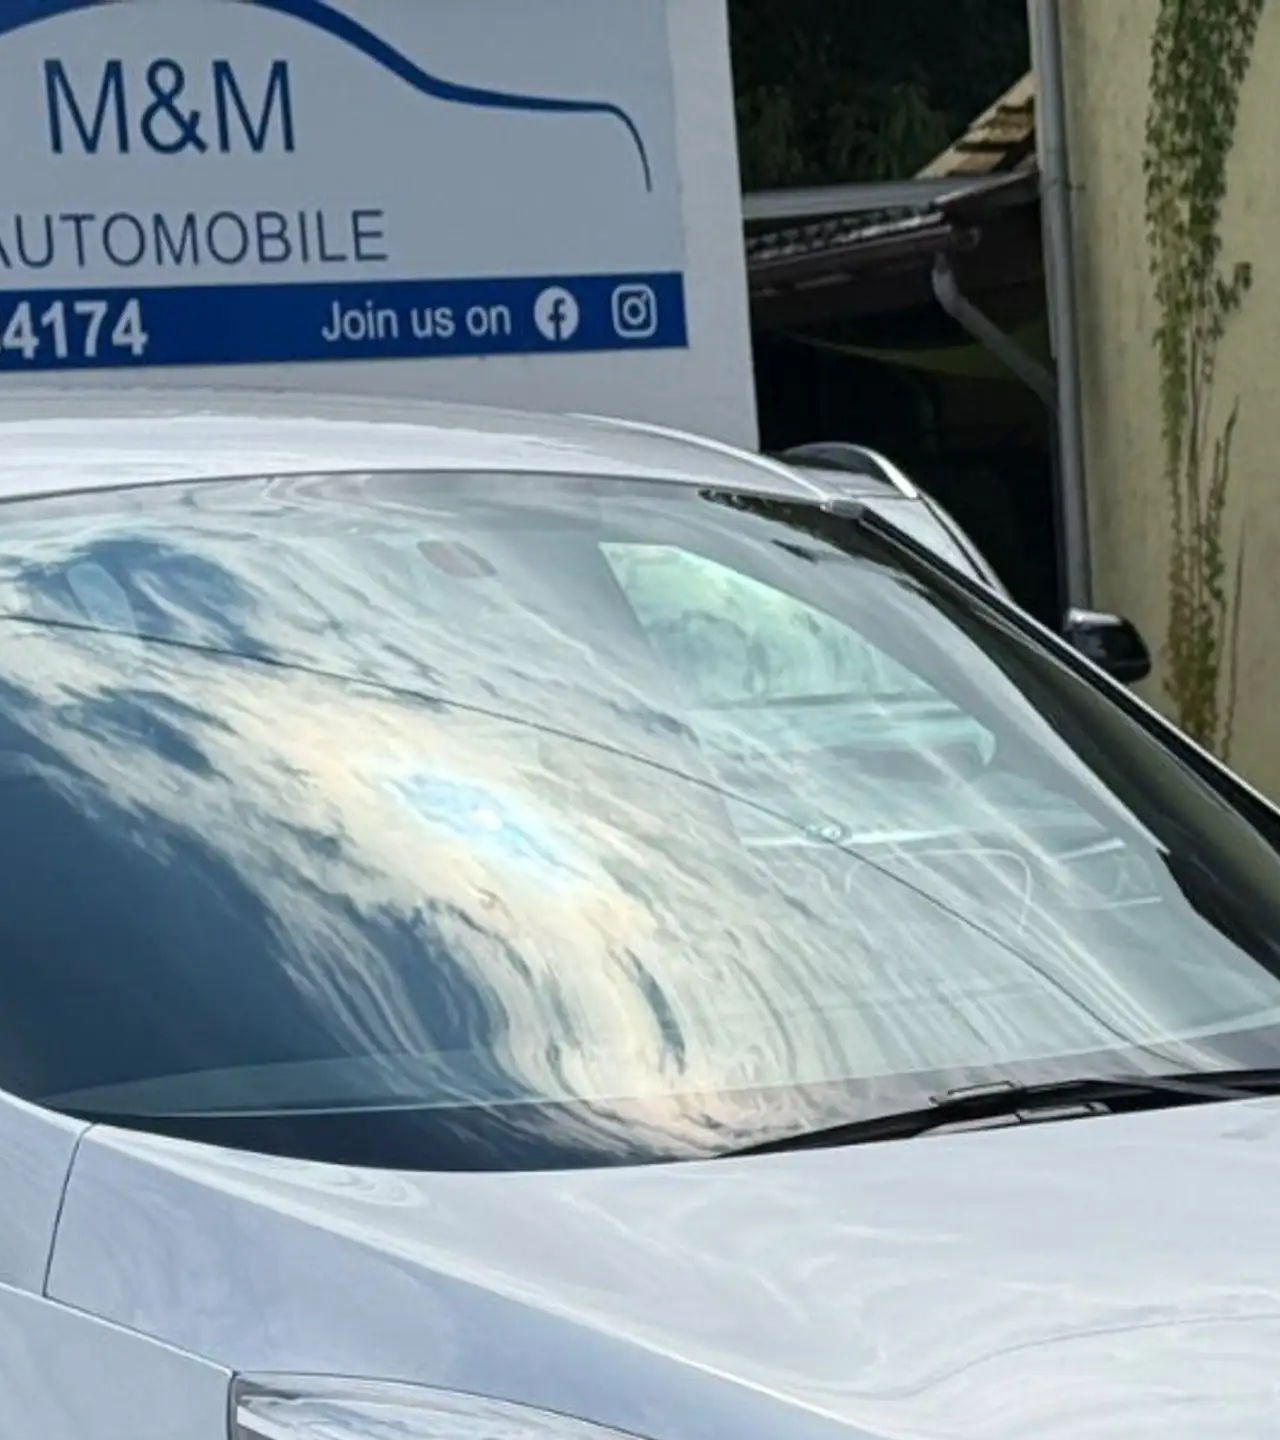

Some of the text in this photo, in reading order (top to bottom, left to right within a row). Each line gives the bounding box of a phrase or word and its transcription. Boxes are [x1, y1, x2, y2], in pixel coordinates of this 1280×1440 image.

[44, 58, 297, 155] M&M
[321, 300, 513, 343] Join us on
